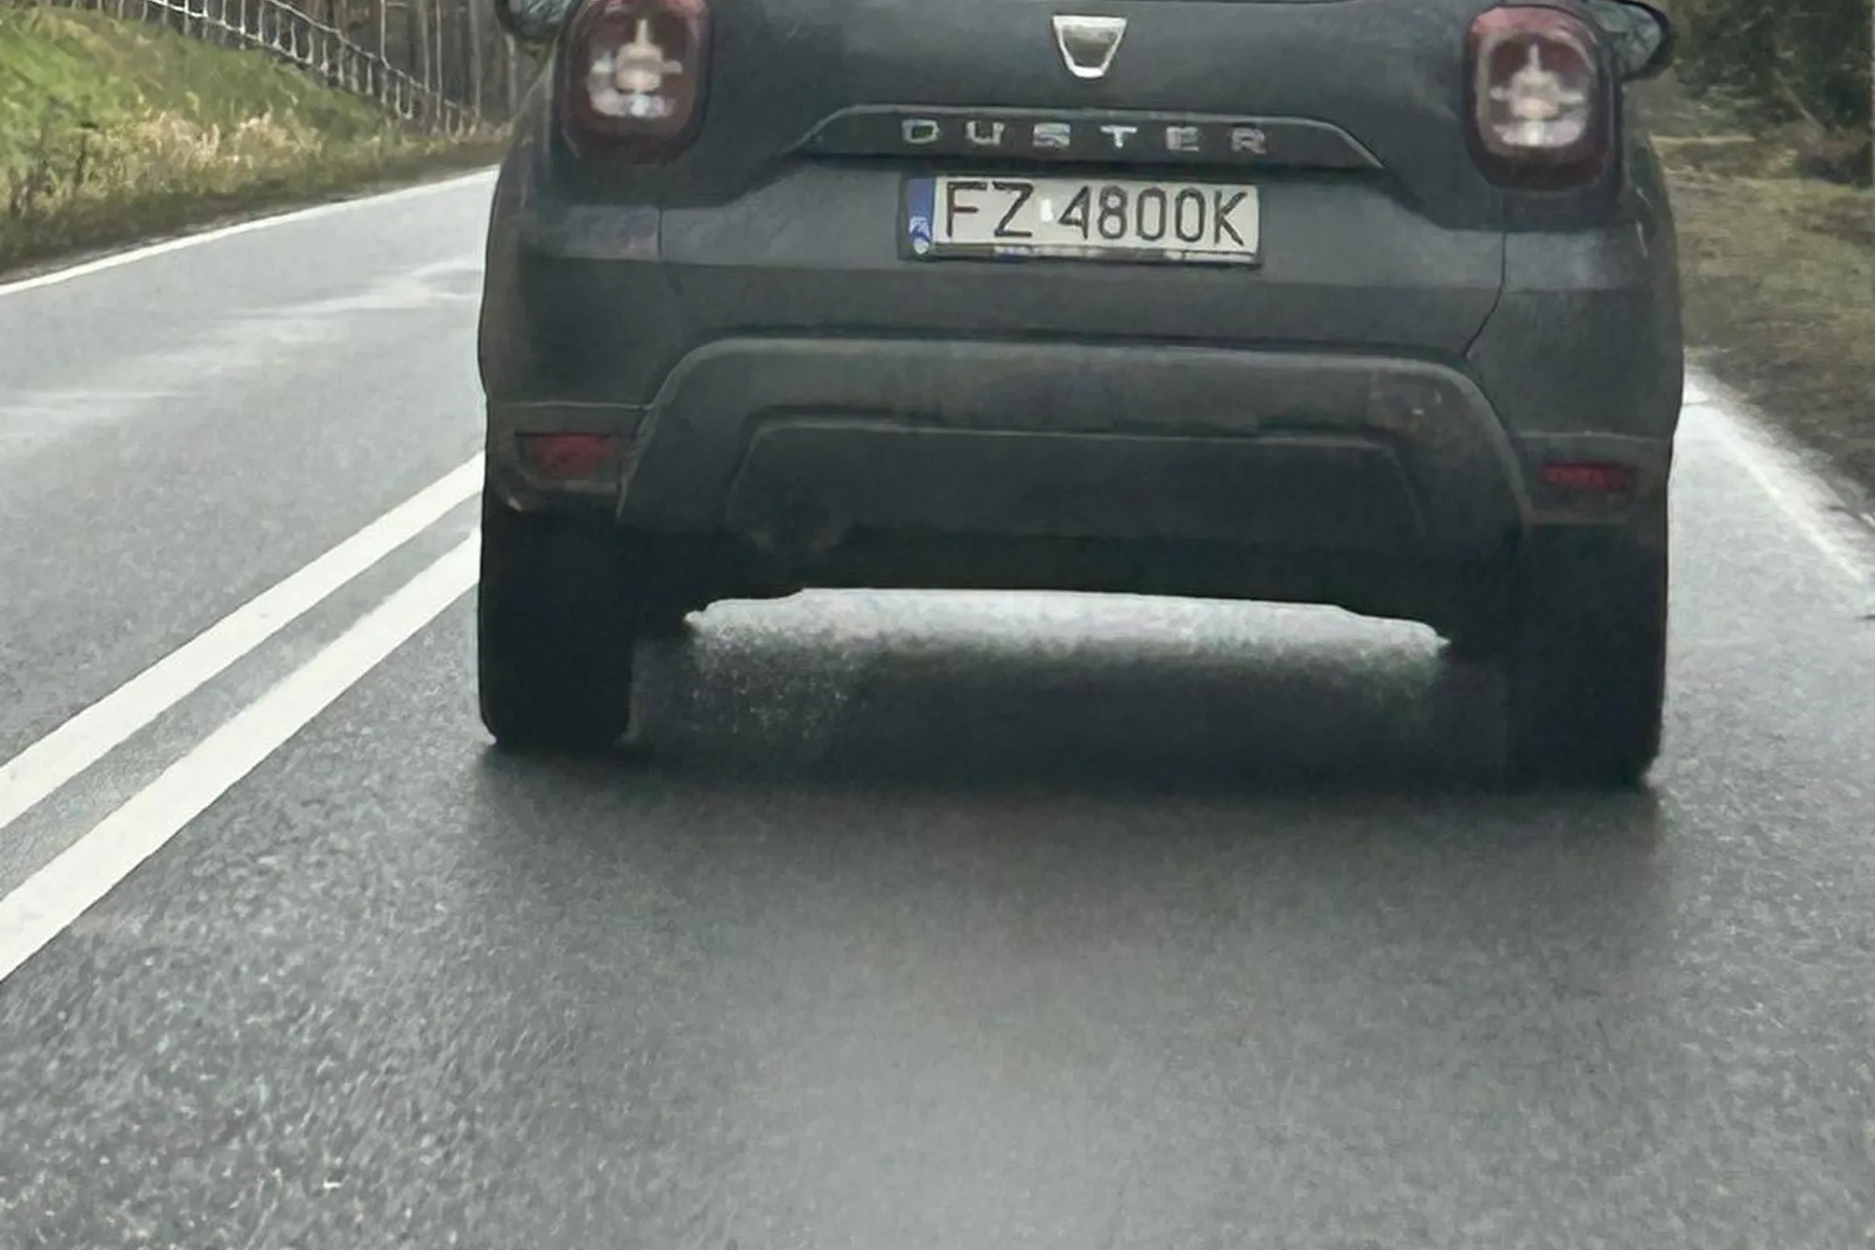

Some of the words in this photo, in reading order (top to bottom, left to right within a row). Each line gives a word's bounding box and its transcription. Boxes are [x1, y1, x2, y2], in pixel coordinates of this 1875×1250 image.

[901, 119, 1266, 154] DUSTER
[946, 181, 1034, 238] FZ
[1058, 185, 1247, 246] 4800K
